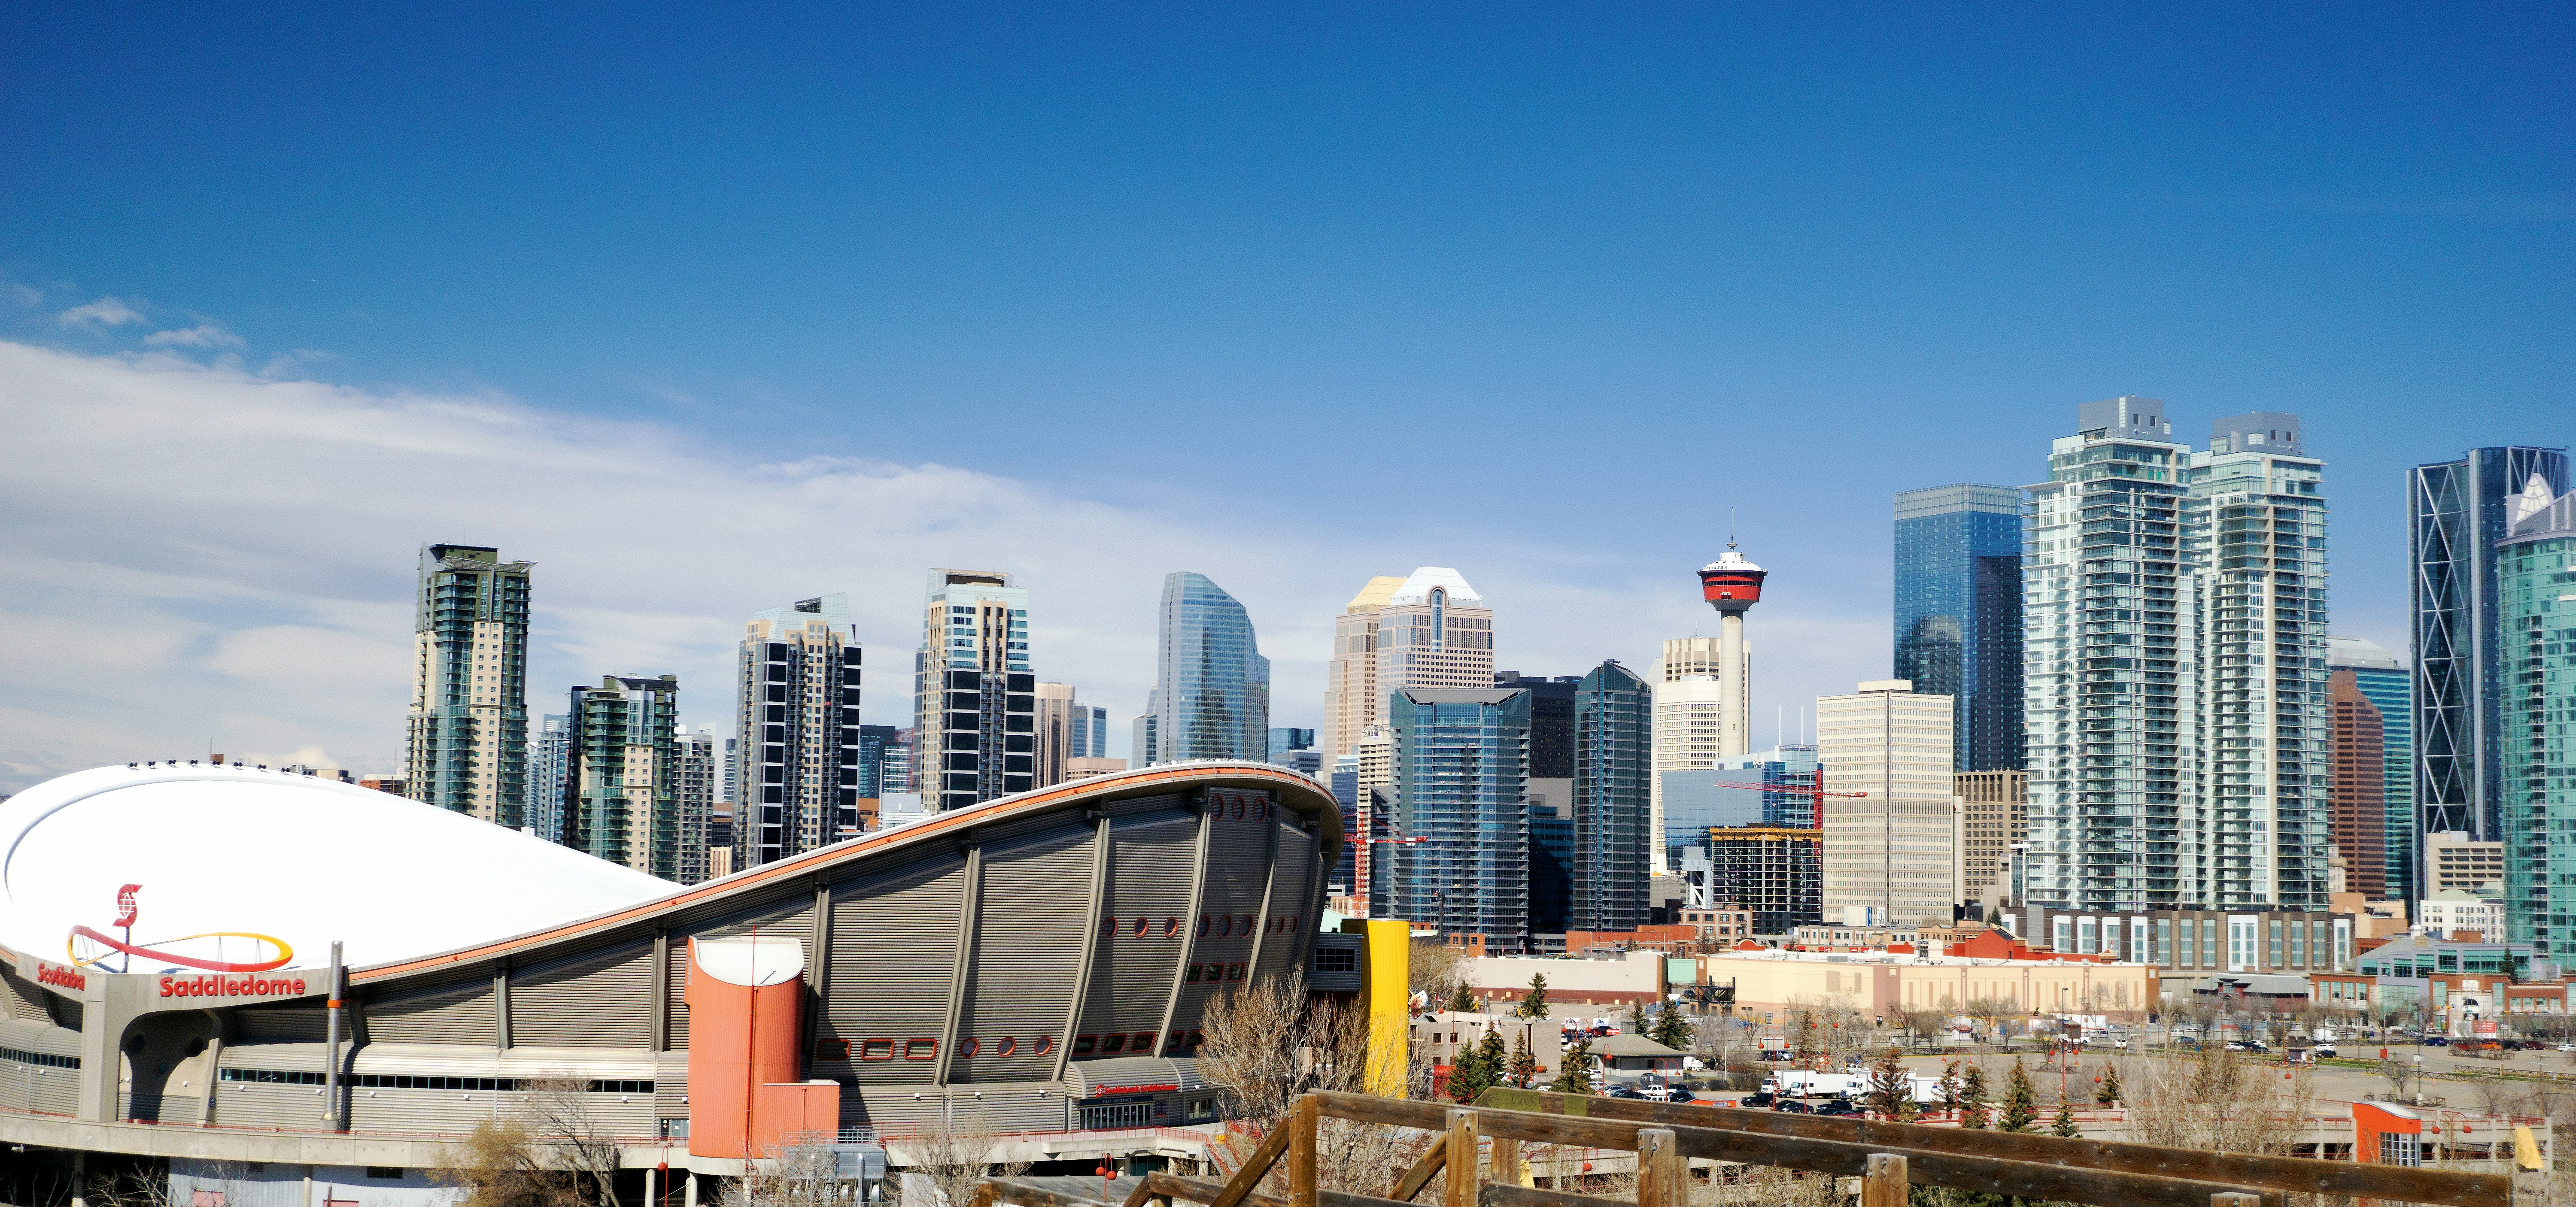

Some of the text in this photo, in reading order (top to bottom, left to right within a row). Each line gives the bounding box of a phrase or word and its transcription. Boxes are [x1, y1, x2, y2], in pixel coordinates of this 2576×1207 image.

[37, 962, 85, 991] Scotiaba
[159, 975, 306, 997] Saddledome
[1104, 1085, 1139, 1094] Scotiabank
